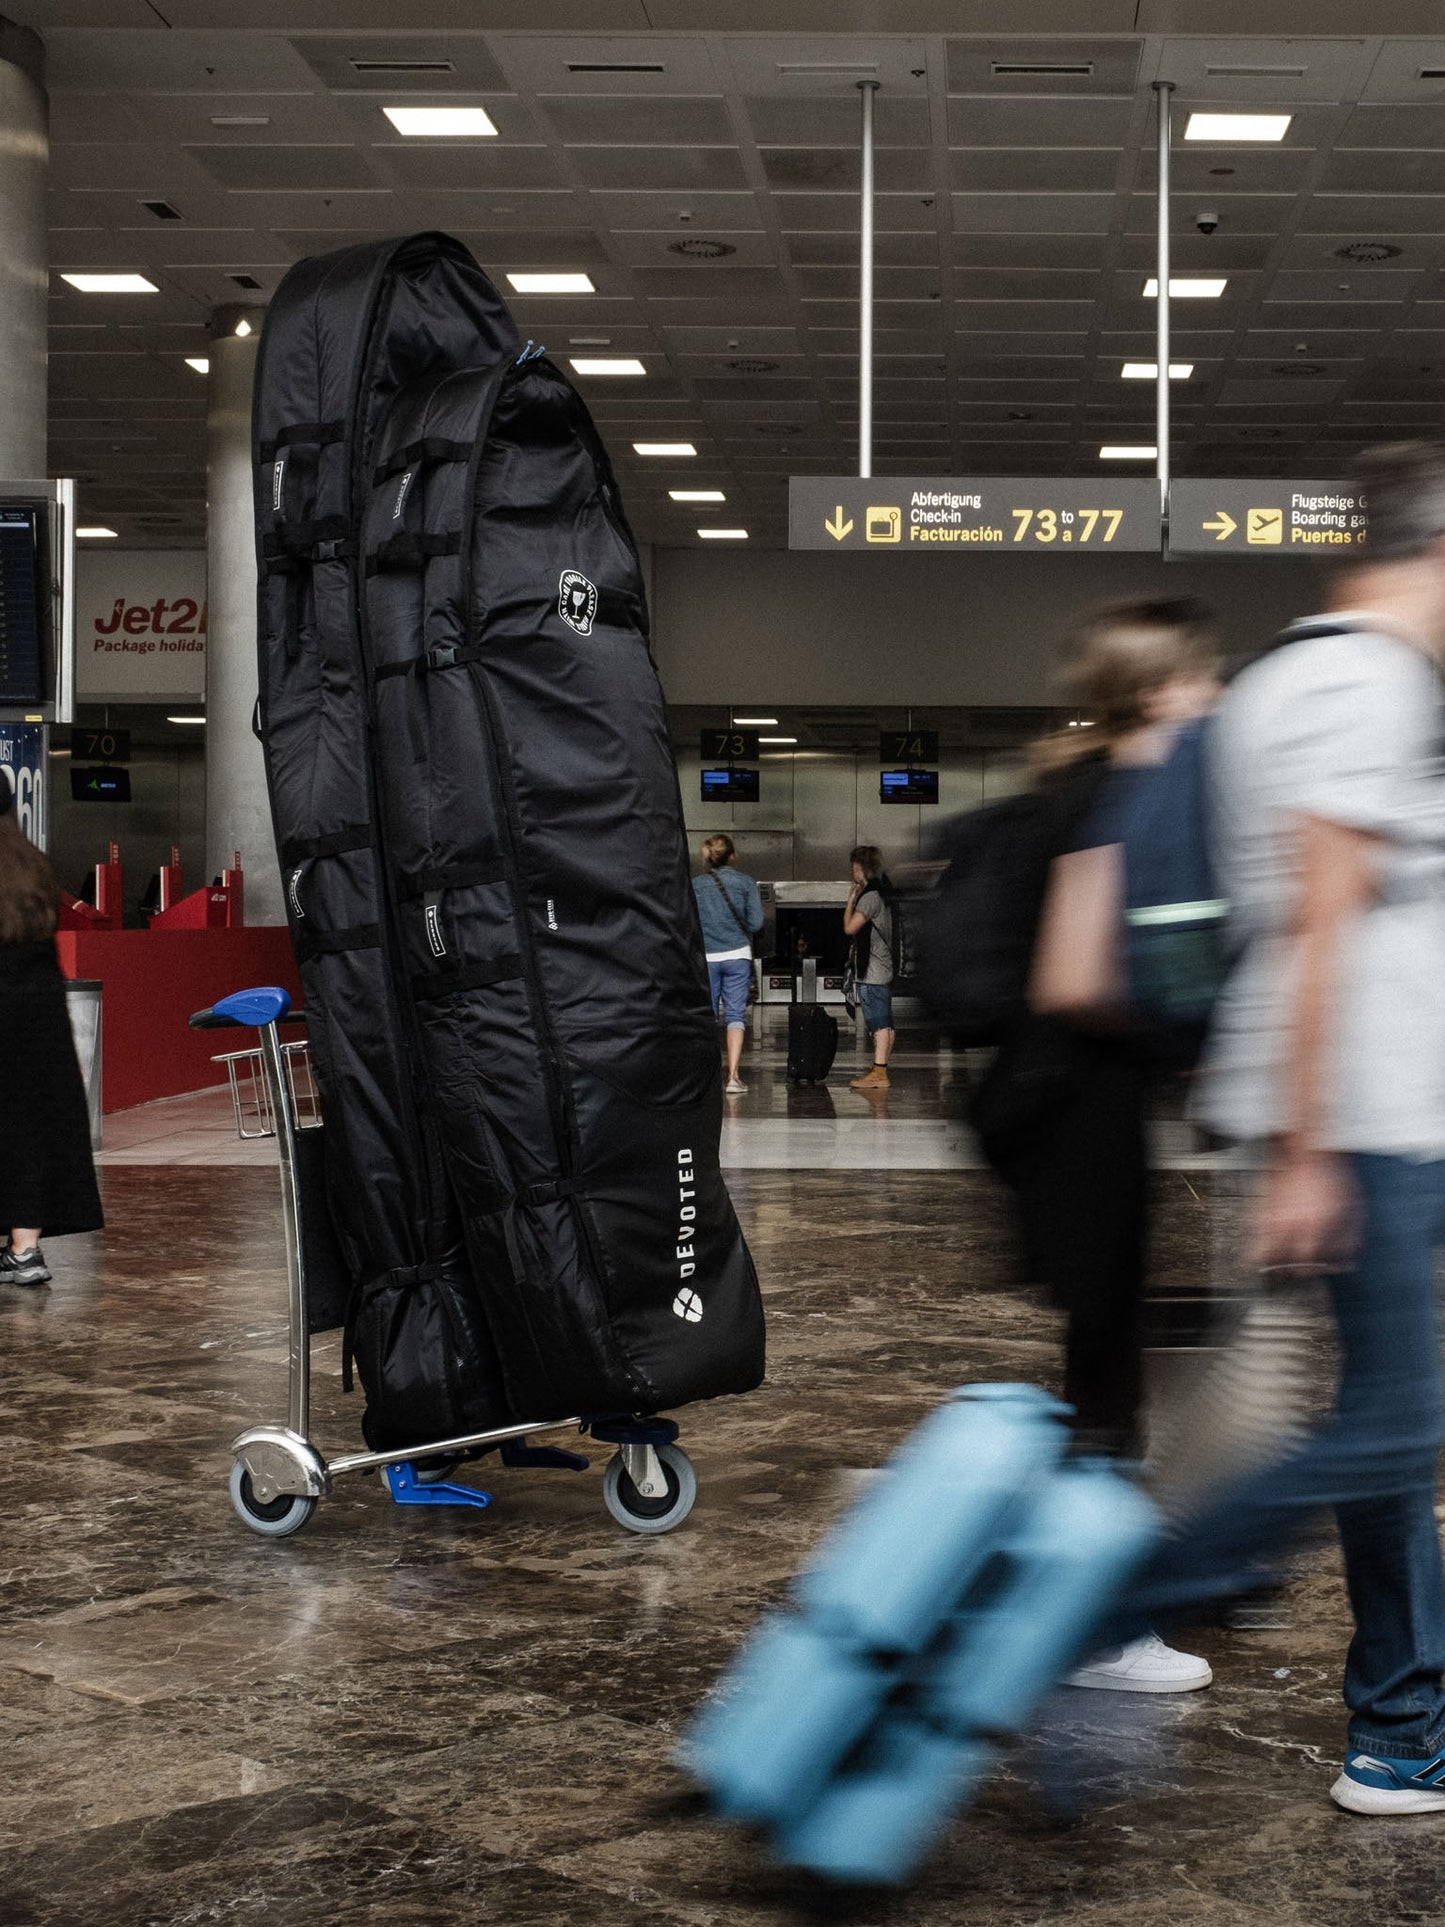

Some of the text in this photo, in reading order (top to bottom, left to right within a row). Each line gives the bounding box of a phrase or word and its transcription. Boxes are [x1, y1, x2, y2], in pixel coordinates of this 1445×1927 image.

[910, 492, 982, 509] Abfertigung
[1291, 494, 1355, 511] Flugsteige
[910, 509, 962, 523] Check-in
[1291, 511, 1347, 528] Boarding
[910, 526, 1003, 542] Facturación
[1012, 509, 1123, 543] 73 to 77
[1062, 530, 1072, 542] a
[1291, 527, 1352, 543] Puertas
[94, 639, 207, 654] Package holida
[86, 735, 115, 755] 70
[715, 735, 745, 756] 73
[895, 737, 923, 757] 74
[676, 1148, 697, 1279] DEVOTED
